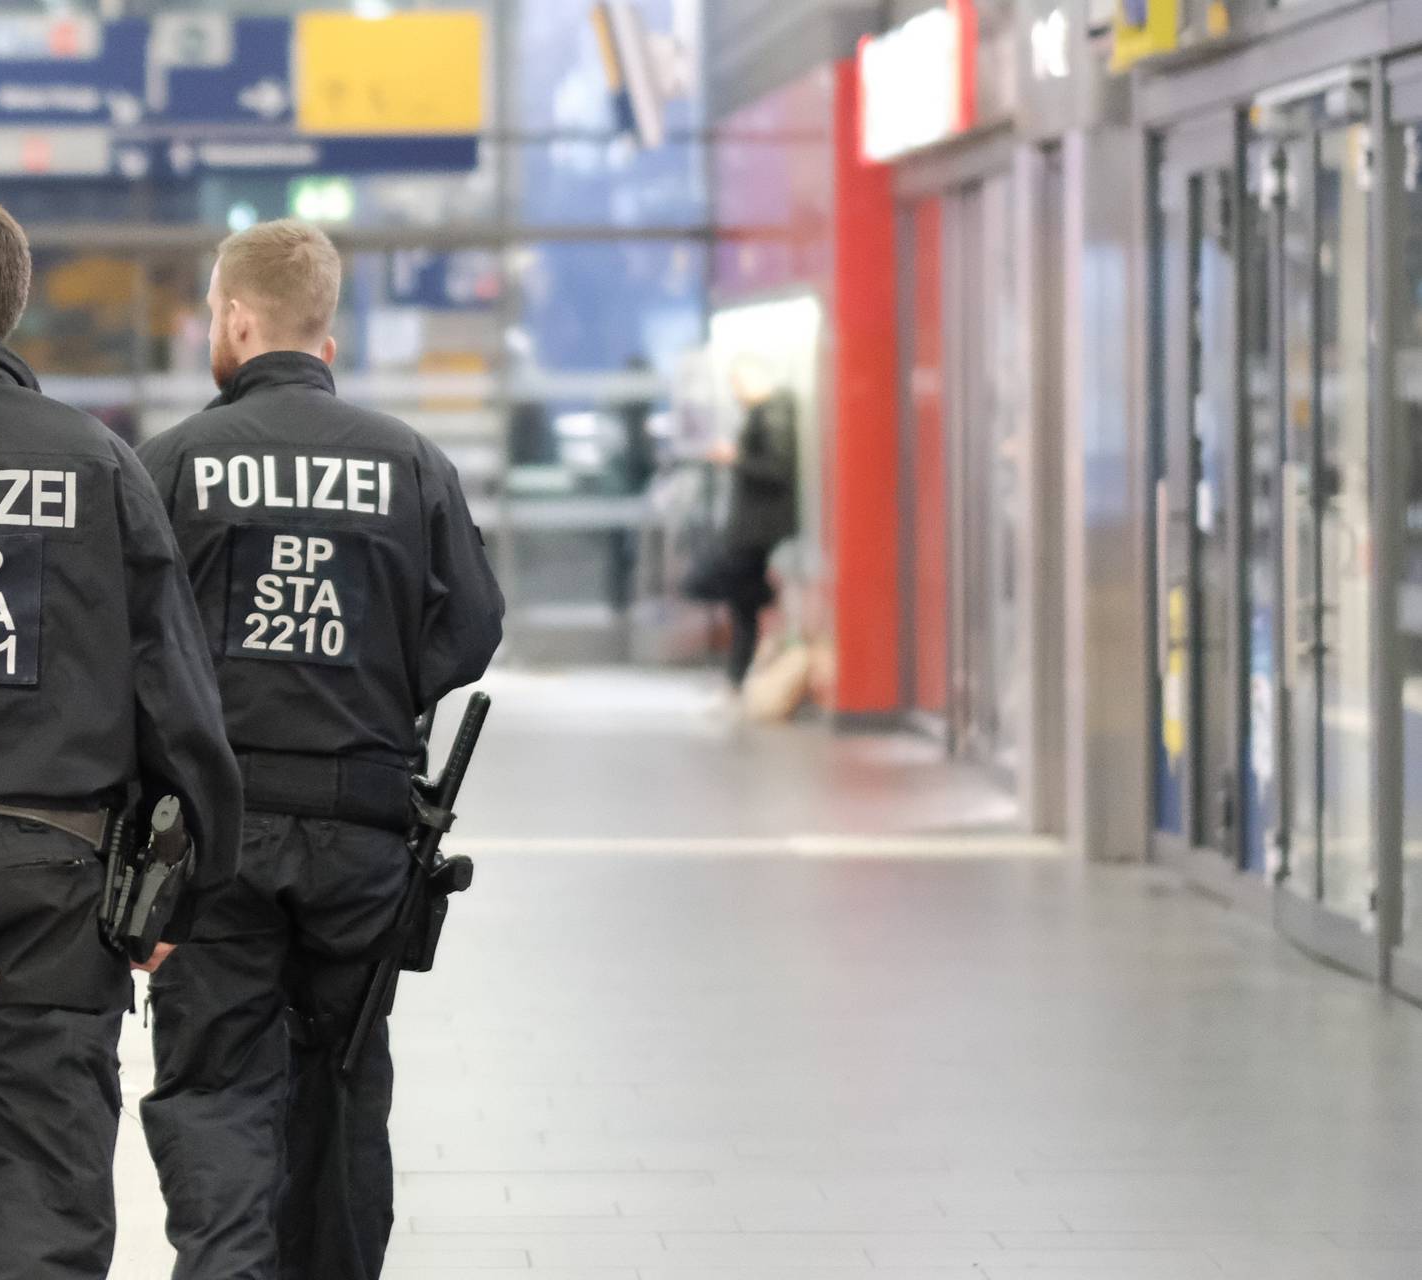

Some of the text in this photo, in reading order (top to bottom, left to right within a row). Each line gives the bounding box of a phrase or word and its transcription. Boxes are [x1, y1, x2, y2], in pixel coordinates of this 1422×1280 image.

[193, 454, 392, 516] POLIZEI
[271, 534, 334, 573] BP
[253, 574, 342, 617] STA
[241, 612, 345, 657] 2210
